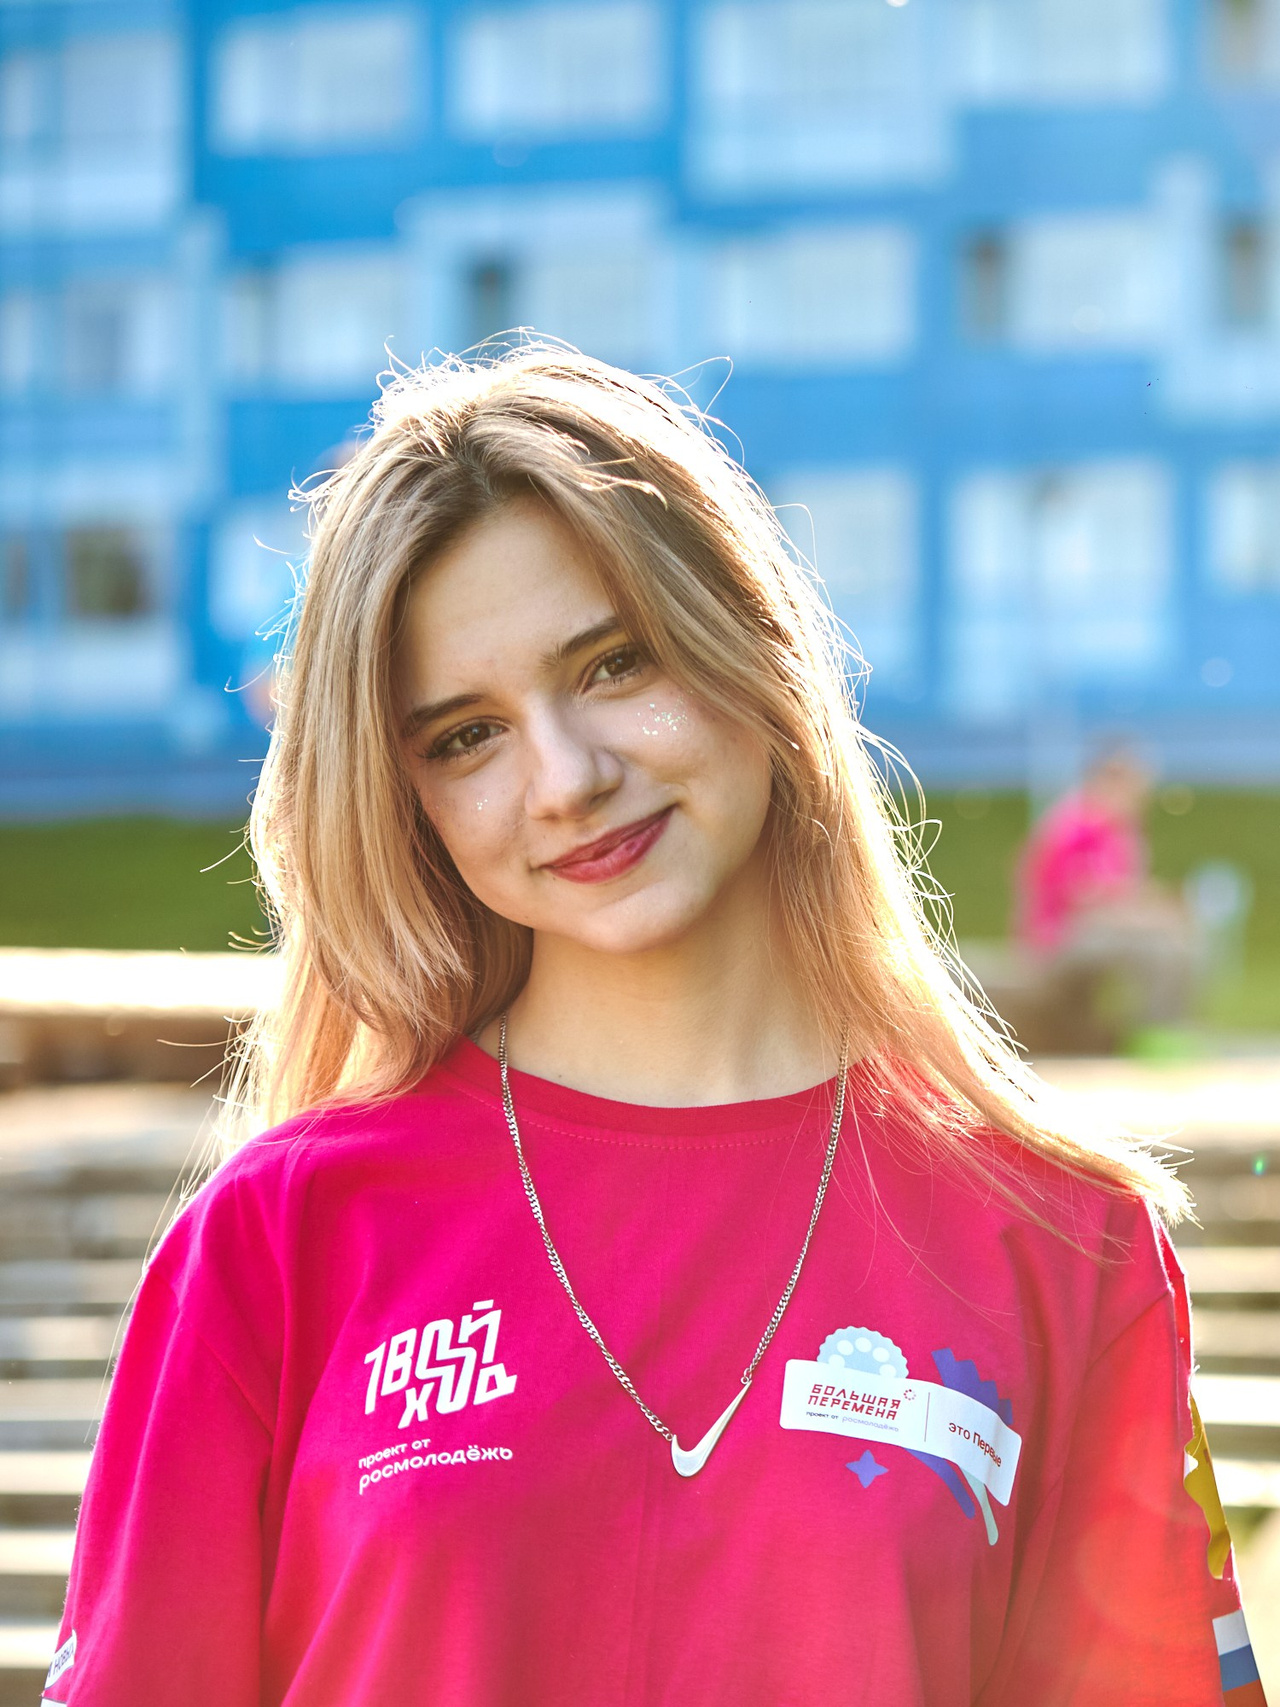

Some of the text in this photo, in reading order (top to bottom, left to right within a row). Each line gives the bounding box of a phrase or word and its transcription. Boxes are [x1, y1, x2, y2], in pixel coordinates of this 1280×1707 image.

[807, 1394, 898, 1421] ПЕРЕМЕНА
[811, 1383, 901, 1410] БОЛЬШАЯ
[806, 1410, 829, 1419] проект
[358, 1438, 432, 1469] проект от
[948, 1422, 1002, 1468] это Первые
[359, 1444, 514, 1496] росмолодёжь
